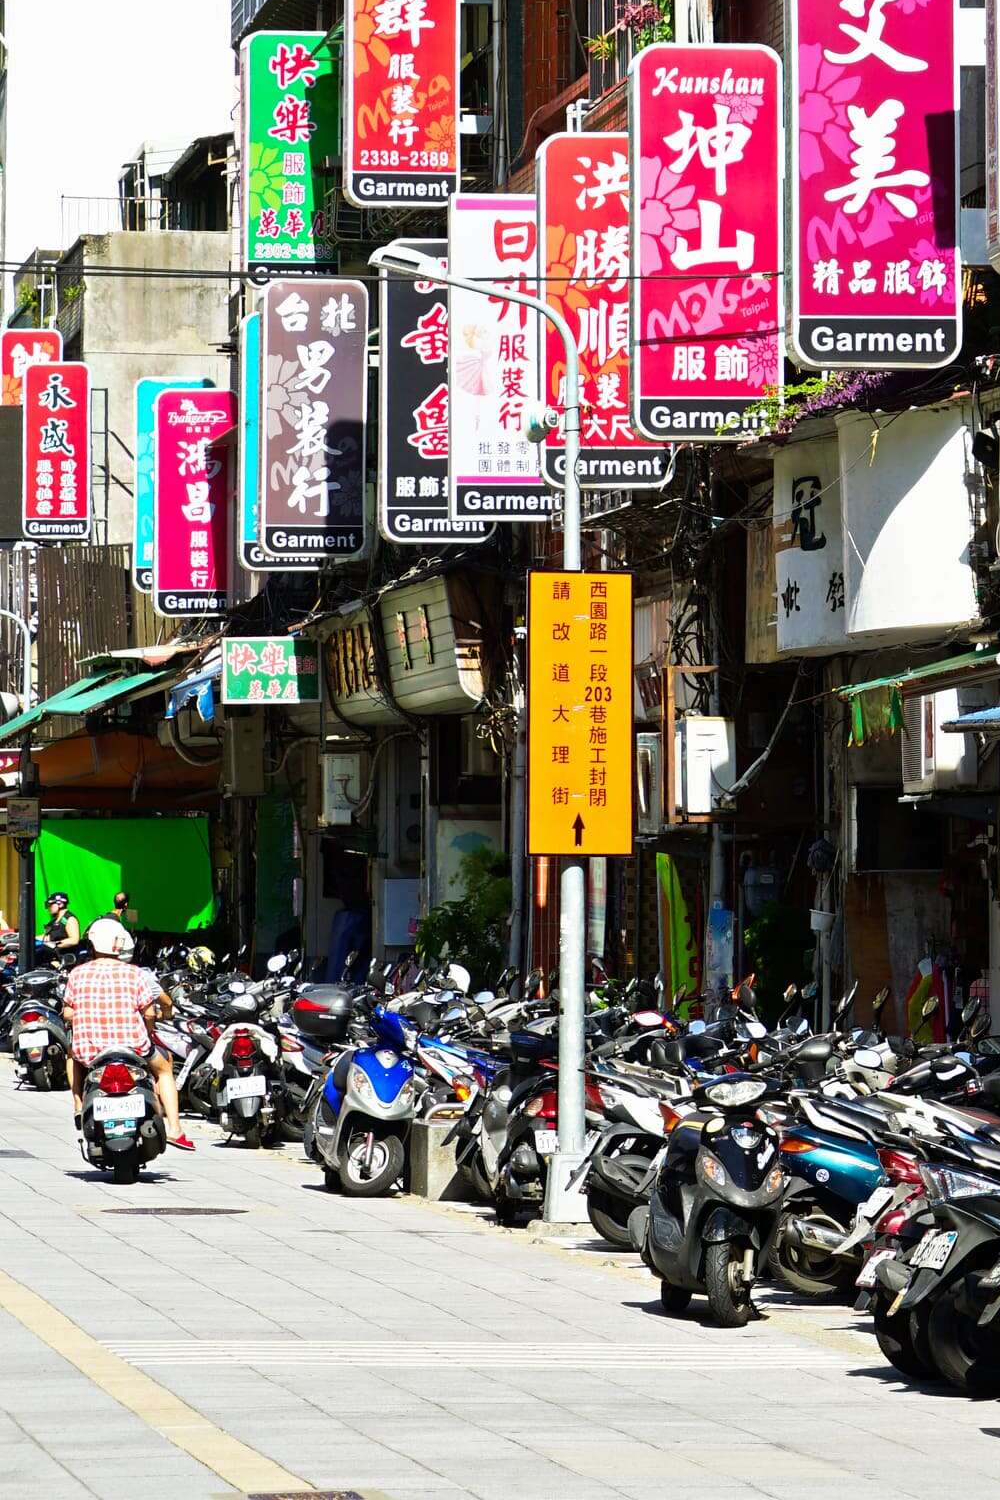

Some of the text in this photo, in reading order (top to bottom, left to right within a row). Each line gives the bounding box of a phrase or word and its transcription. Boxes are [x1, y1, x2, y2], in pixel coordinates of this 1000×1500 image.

[652, 67, 765, 97] Kunshan
[360, 150, 449, 167] 2338-2389
[359, 178, 449, 198] Garment
[663, 103, 755, 270] 坤山
[812, 259, 947, 296] 精品服飾
[275, 291, 357, 332] 台北
[810, 327, 945, 354] Garment
[671, 345, 749, 382] 服飾
[286, 340, 343, 517] 男裝行
[464, 492, 561, 511] Garment
[28, 521, 84, 534] Garment
[272, 530, 356, 548] Garment
[552, 581, 570, 806] 請改道大理街
[584, 581, 612, 807] 西園路一段203巷施工封閉
